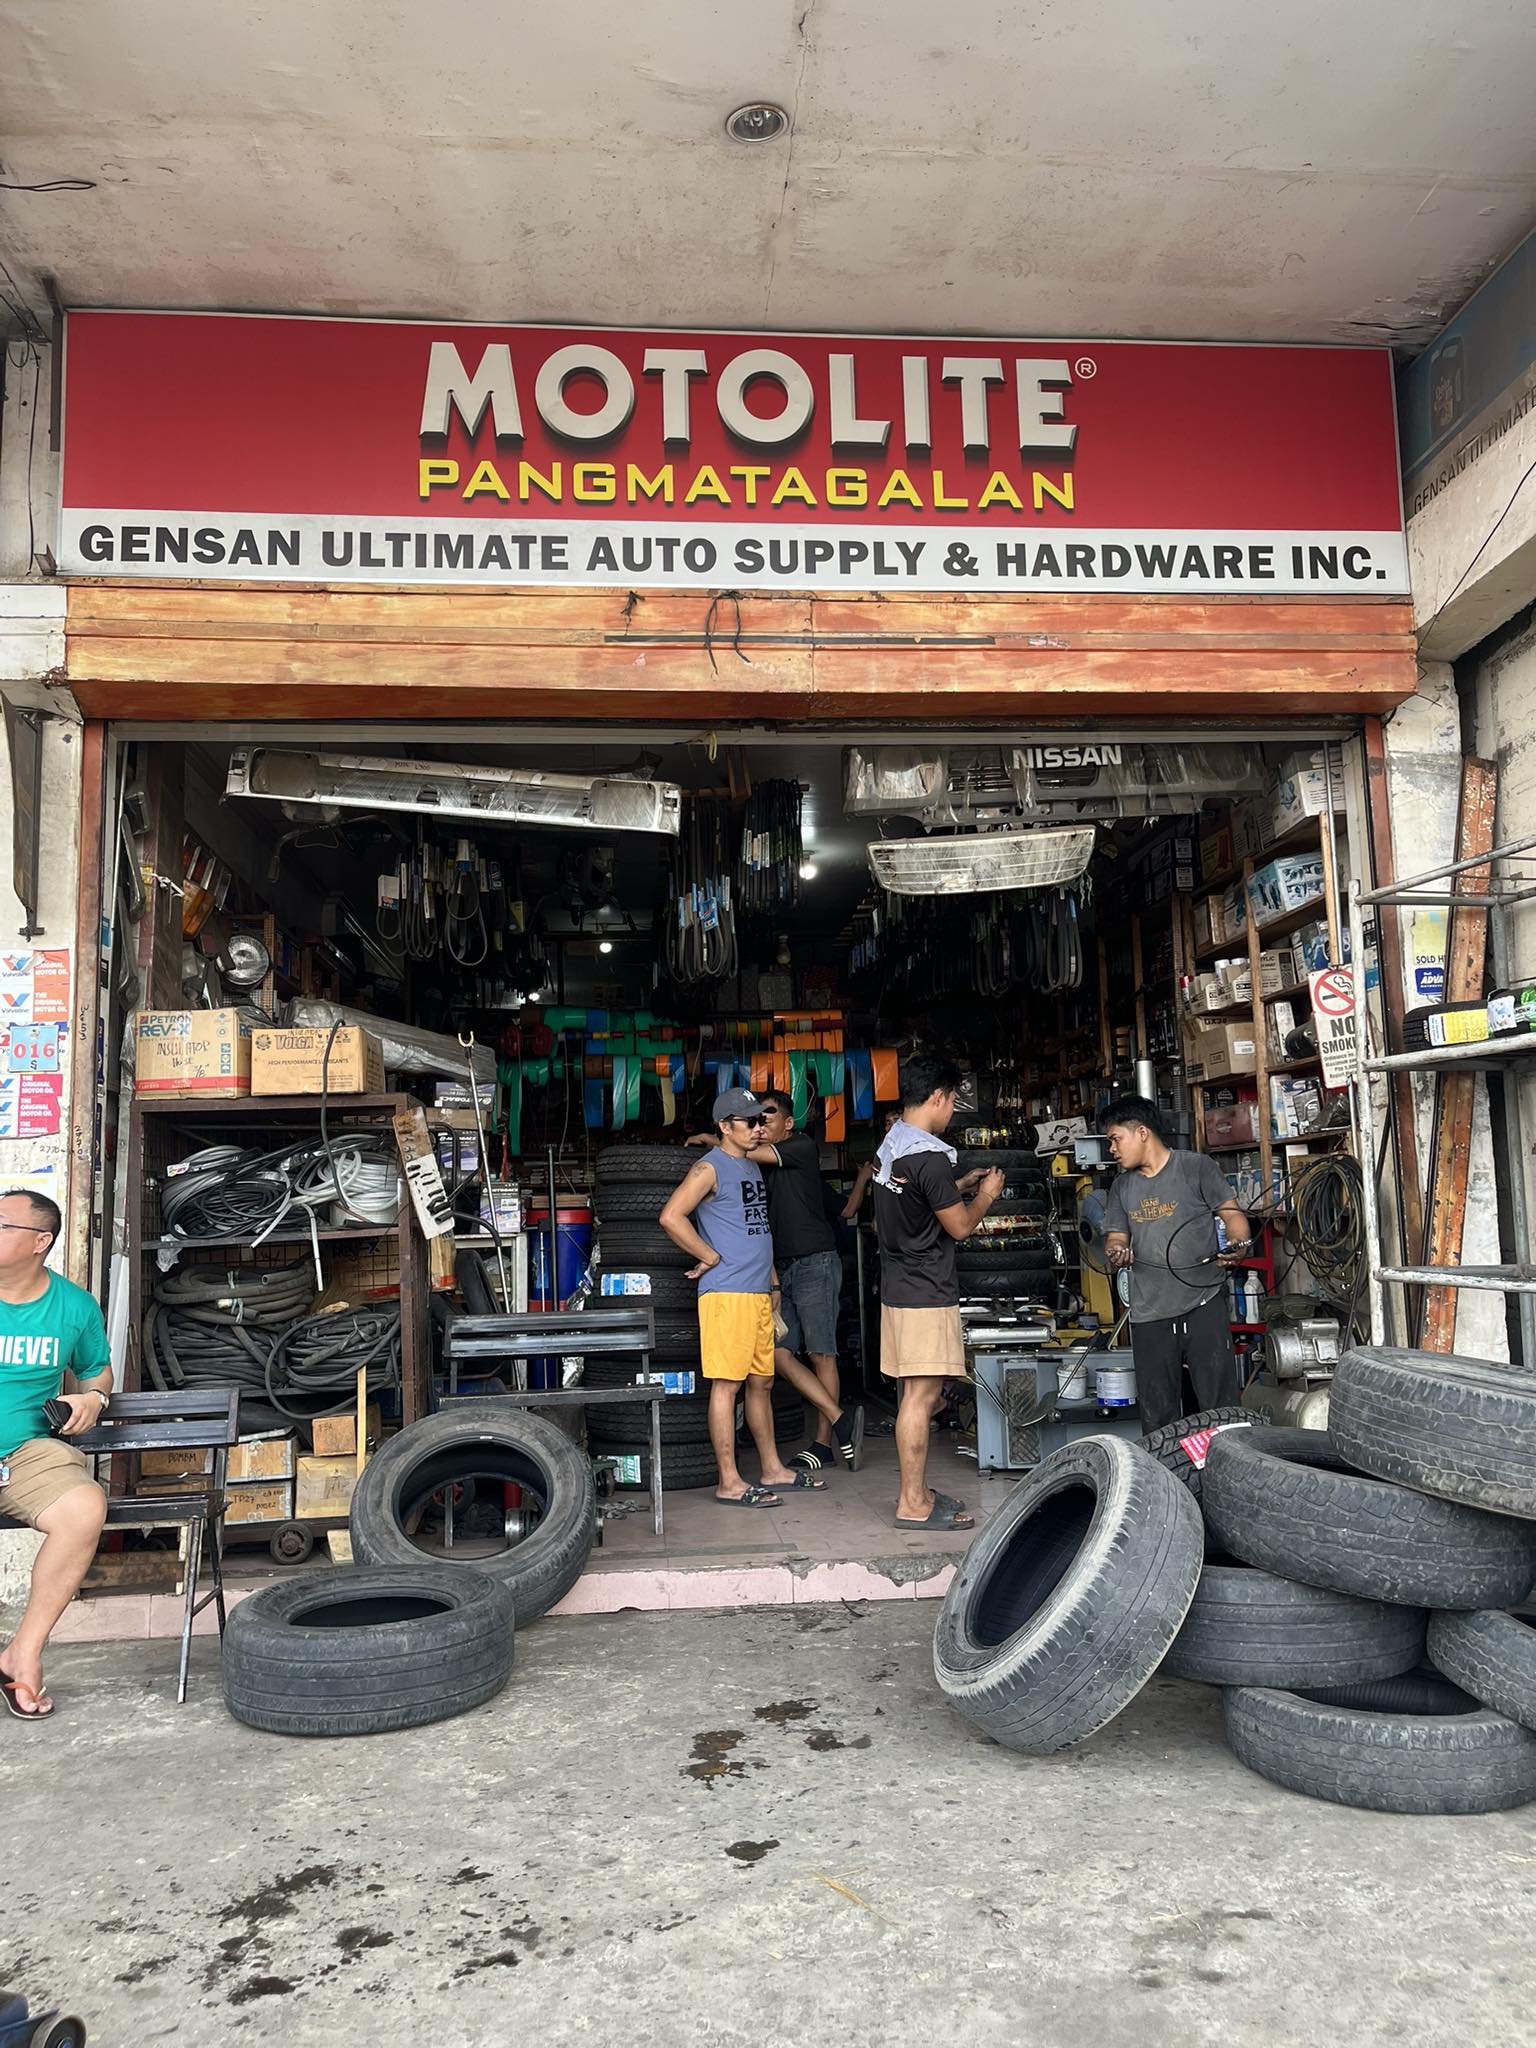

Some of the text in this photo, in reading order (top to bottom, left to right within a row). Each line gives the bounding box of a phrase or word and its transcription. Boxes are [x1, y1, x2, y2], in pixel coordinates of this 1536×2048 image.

[420, 342, 1077, 450] MOTOLITE
[420, 460, 1074, 510] PANGMATAGALAN
[79, 525, 1387, 580] GENSAN ULTIMATE AUTO SUPPLY & HARDWARE INC.
[1012, 744, 1123, 770] NISSAN
[1416, 955, 1436, 964] SOLD
[1420, 975, 1444, 985] ADVA
[150, 1014, 192, 1024] PETRON
[1330, 1015, 1356, 1038] NO
[140, 1024, 190, 1037] REV-X
[240, 1024, 253, 1037] RE
[274, 1034, 315, 1050] VOLGA
[1322, 1036, 1356, 1054] SMOKI
[13, 1042, 56, 1060] 016
[741, 1180, 767, 1204] BE
[744, 1207, 768, 1222] FAS
[747, 1227, 762, 1236] BE
